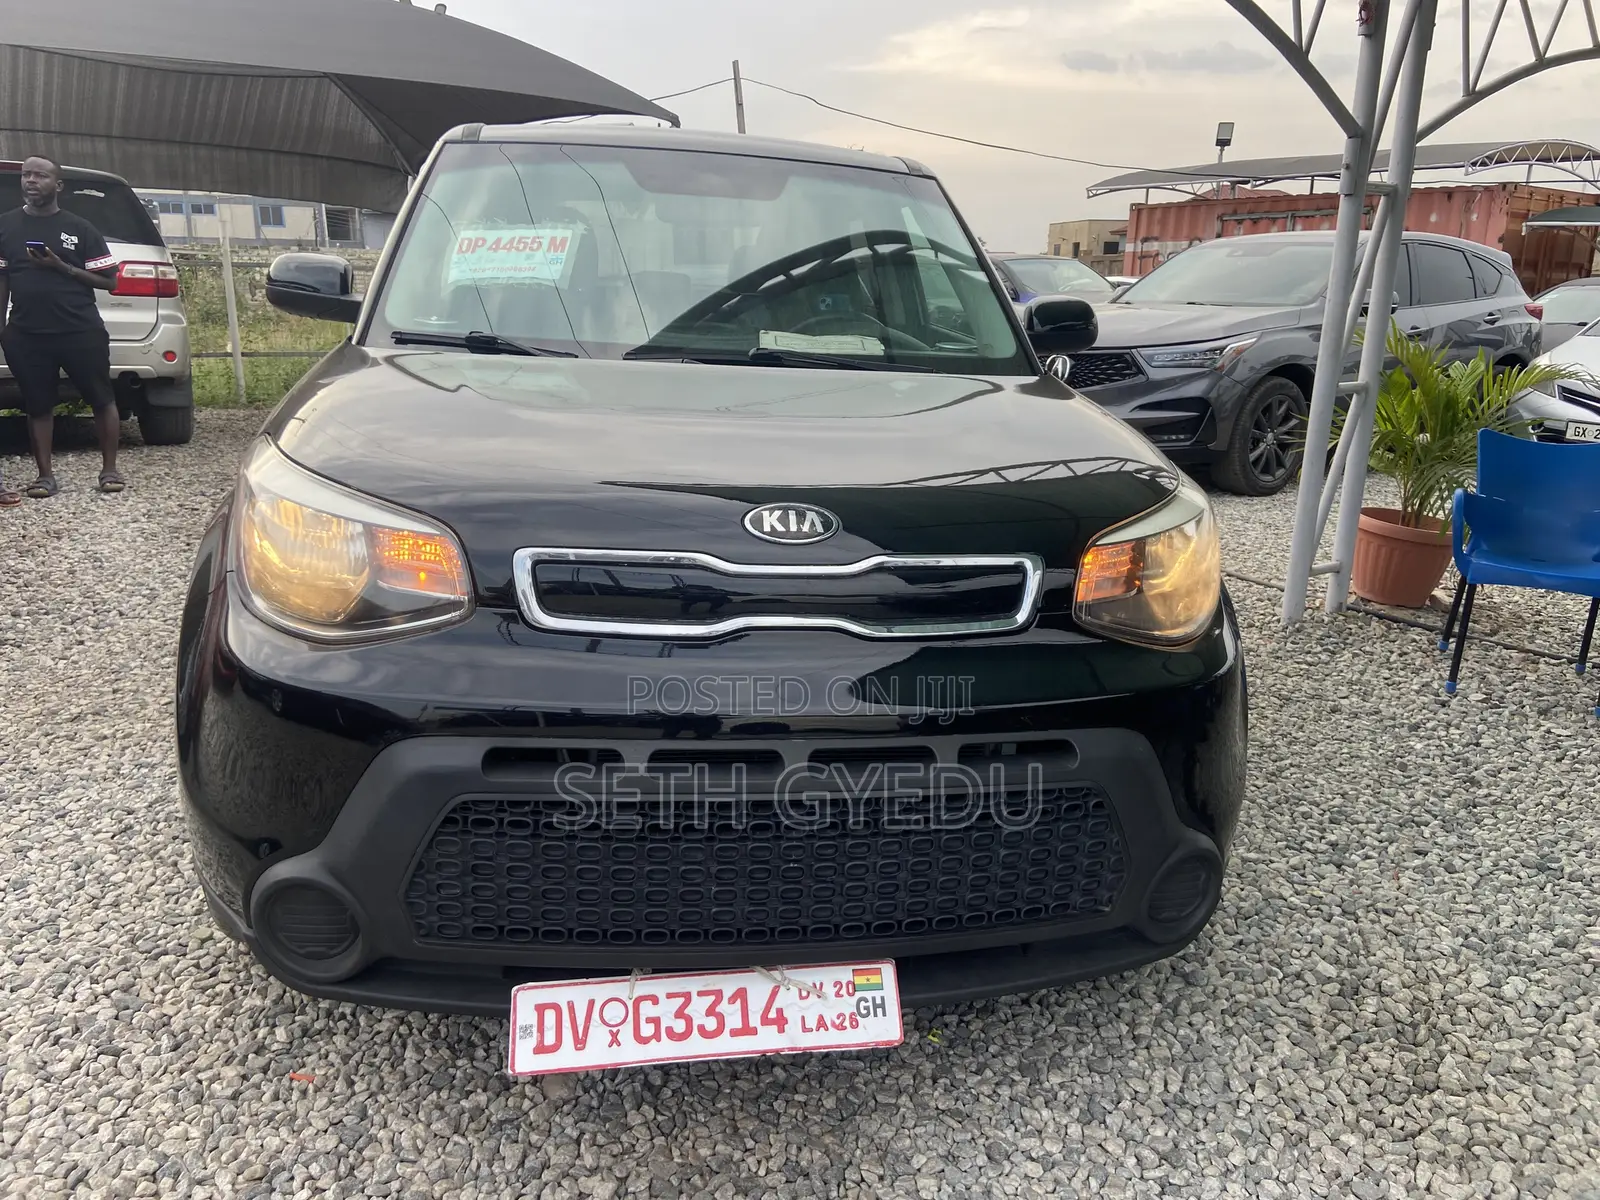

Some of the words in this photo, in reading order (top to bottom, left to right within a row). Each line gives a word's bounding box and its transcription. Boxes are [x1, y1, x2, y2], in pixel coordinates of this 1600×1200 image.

[457, 237, 487, 254] DP
[487, 236, 543, 253] 4455
[547, 236, 569, 253] M
[1574, 426, 1588, 438] GX
[761, 509, 824, 533] KIA
[833, 980, 856, 998] 20
[855, 996, 887, 1019] GH
[532, 999, 596, 1055] DV
[632, 985, 789, 1046] G3314
[800, 1012, 829, 1033] LA
[835, 1011, 859, 1031] 26
